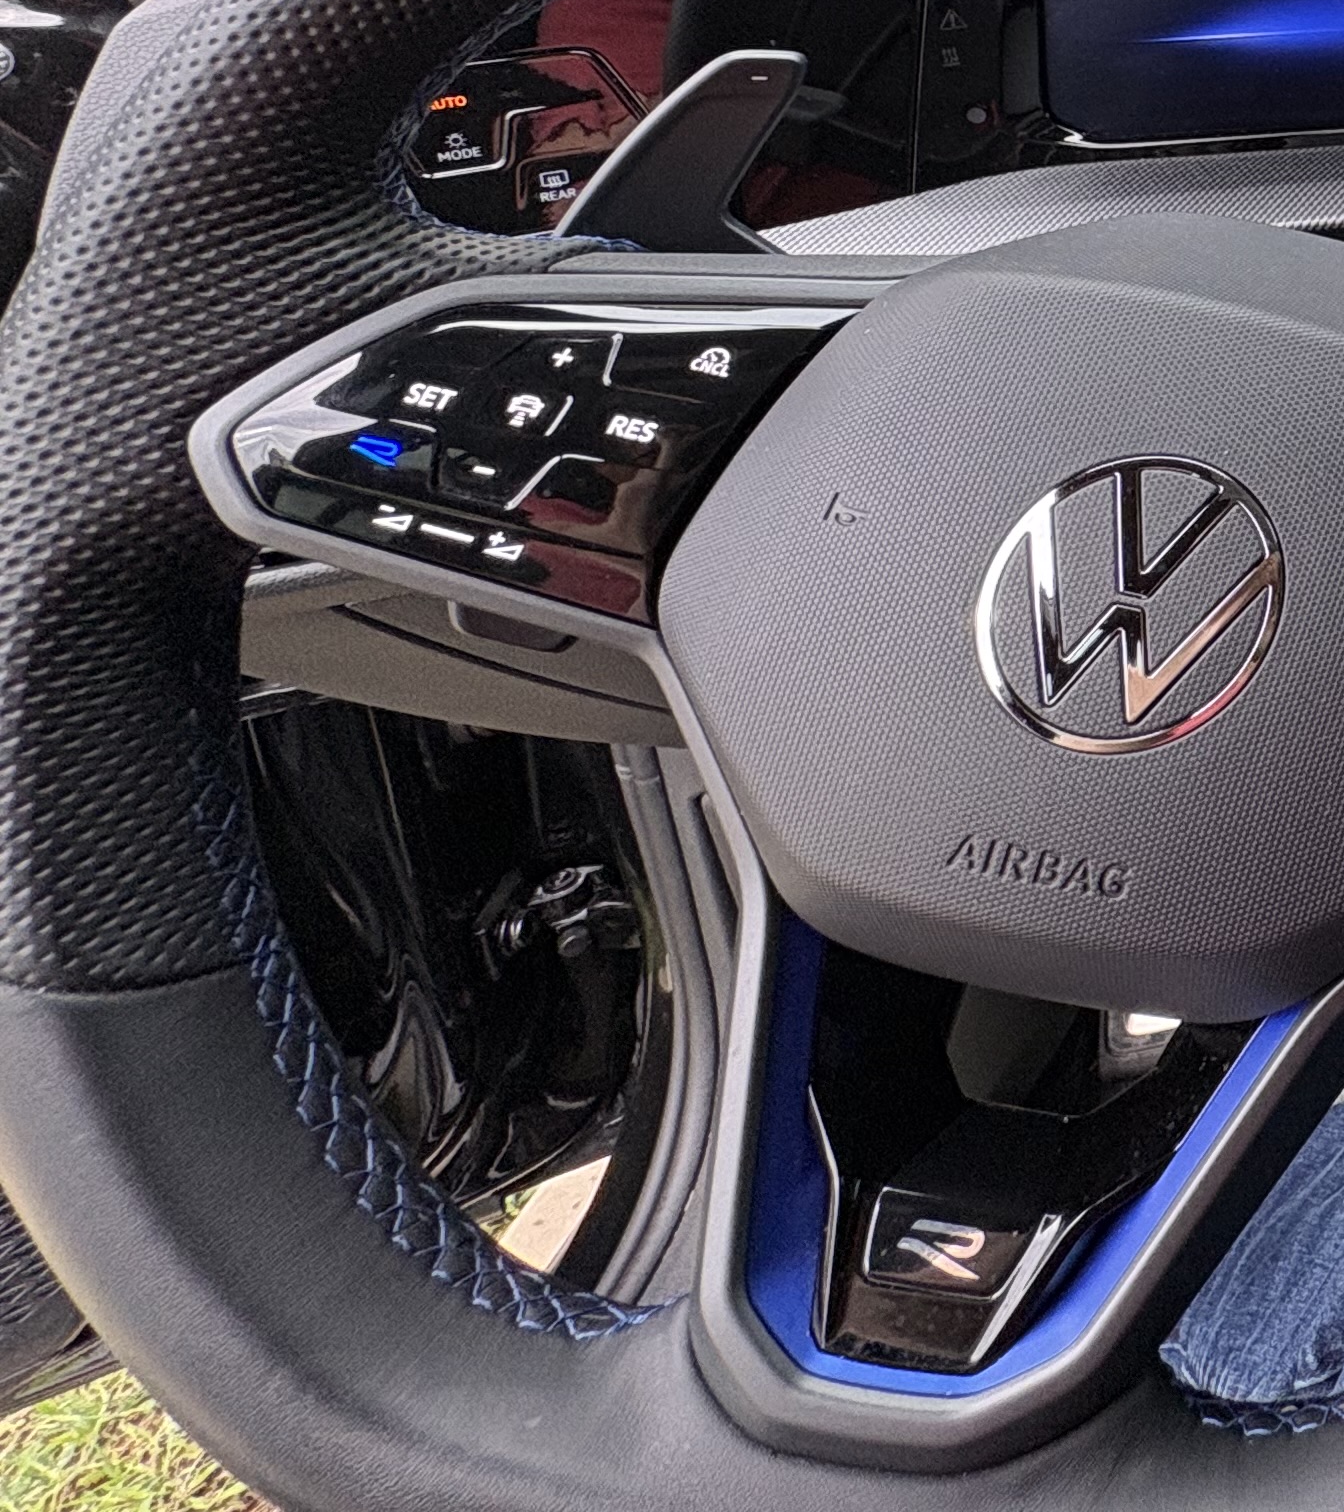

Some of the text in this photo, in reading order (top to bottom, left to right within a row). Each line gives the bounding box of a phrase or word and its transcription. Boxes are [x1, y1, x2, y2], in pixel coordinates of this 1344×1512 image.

[436, 145, 483, 163] MODE
[539, 187, 577, 203] REAR
[690, 357, 730, 378] CNCL
[404, 382, 458, 412] SET
[605, 414, 659, 444] RES
[946, 833, 1132, 901] AIRBAG
